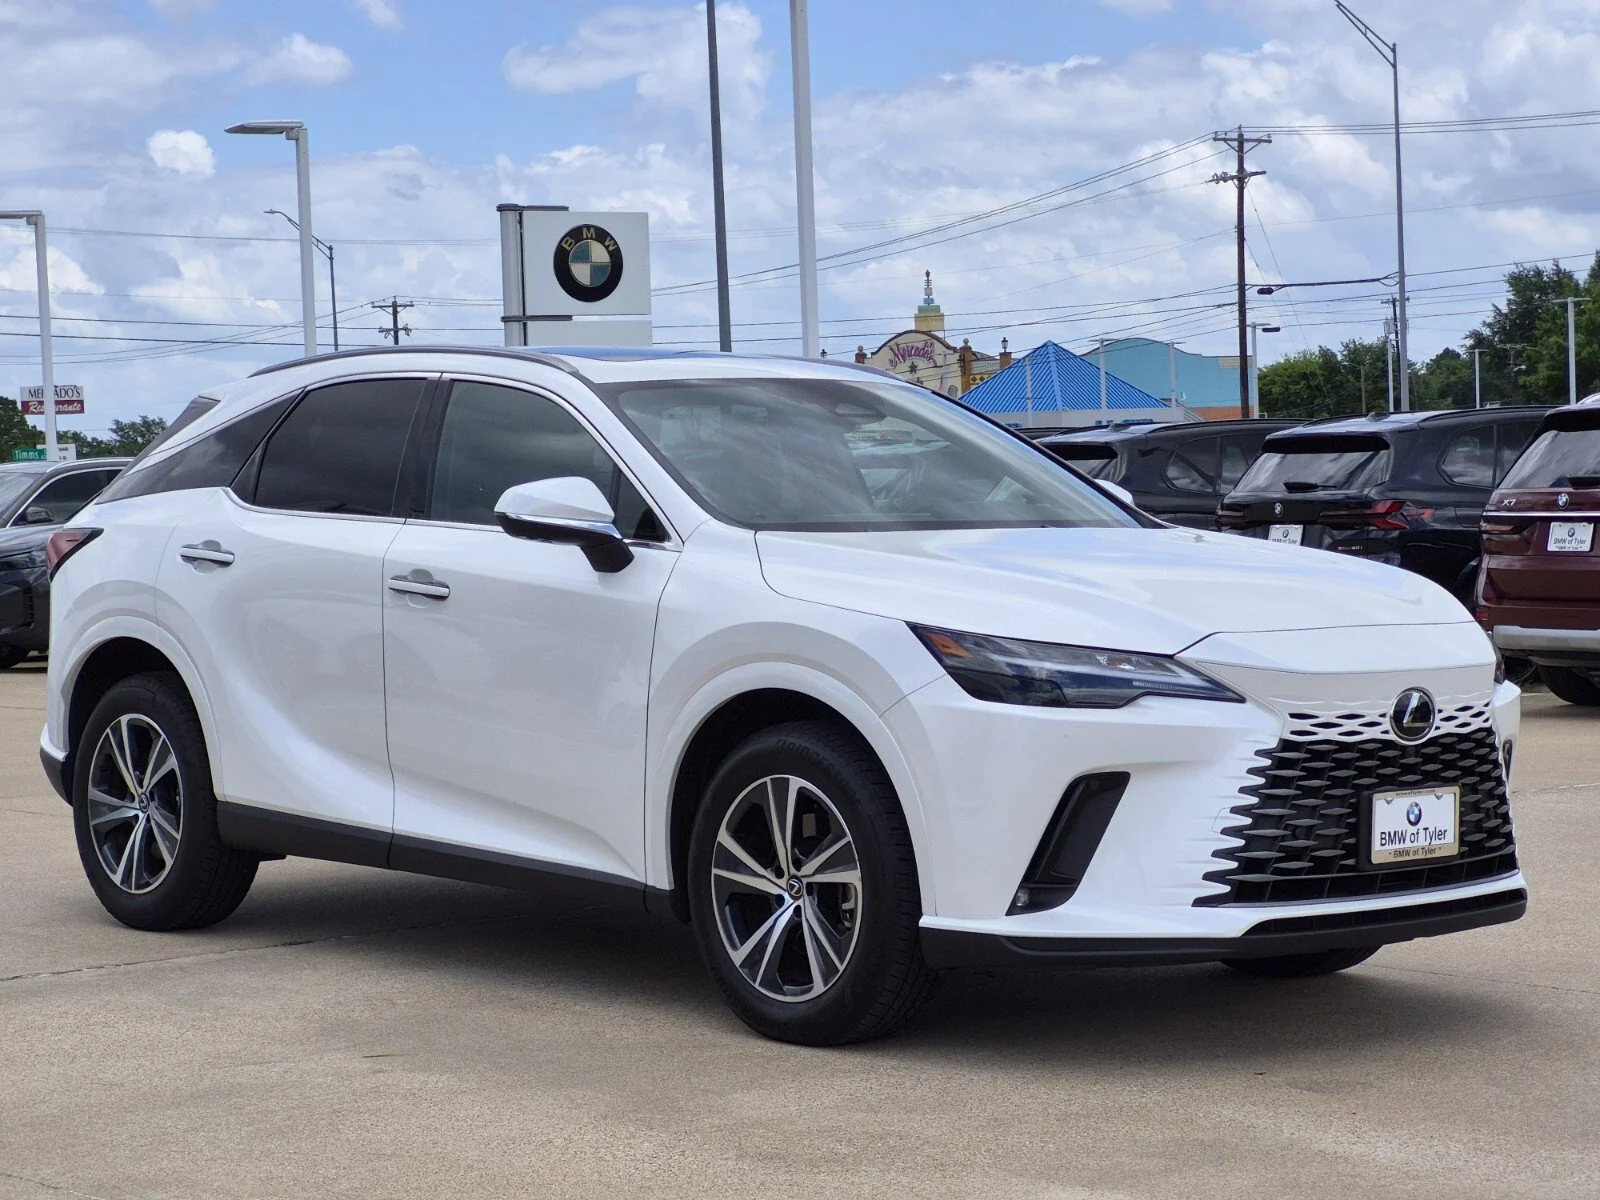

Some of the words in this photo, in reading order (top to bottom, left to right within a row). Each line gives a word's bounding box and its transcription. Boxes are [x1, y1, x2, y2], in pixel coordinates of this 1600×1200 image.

[561, 227, 617, 251] BMW
[15, 450, 39, 460] Timms
[1574, 537, 1587, 546] Tyler
[1380, 830, 1407, 846] BMW
[1409, 828, 1420, 843] of
[1423, 826, 1448, 846] Tyler
[1394, 850, 1410, 858] BMW
[1413, 848, 1420, 856] of
[1421, 847, 1437, 857] Tyler
